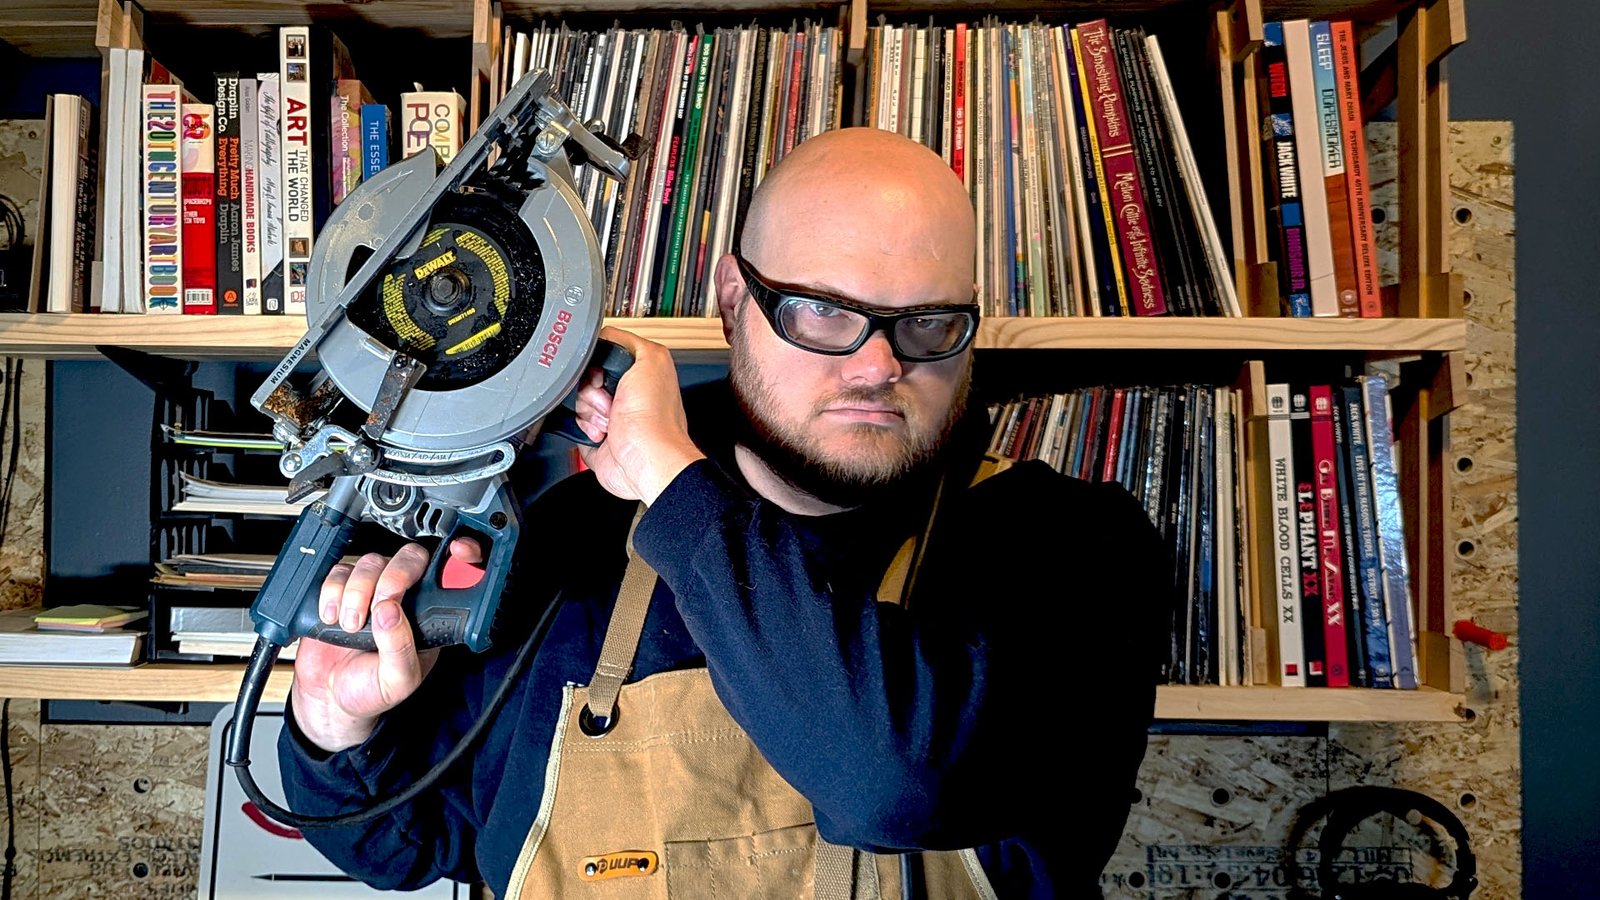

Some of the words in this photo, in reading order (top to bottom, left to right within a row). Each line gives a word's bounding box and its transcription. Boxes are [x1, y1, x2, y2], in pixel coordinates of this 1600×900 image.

[1083, 27, 1106, 46] The
[1339, 30, 1347, 42] THE
[1316, 33, 1332, 71] SLEEP
[1340, 44, 1350, 64] JESUS
[1086, 45, 1112, 93] Smashing
[1269, 62, 1287, 97] WITCH
[1342, 66, 1351, 80] AND
[215, 78, 227, 113] Design
[226, 78, 239, 119] Draplin
[340, 95, 350, 111] The
[1344, 81, 1353, 100] MARY
[218, 113, 227, 134] Co.
[287, 97, 307, 146] ART
[1098, 93, 1121, 138] Pumpkins
[1346, 101, 1355, 122] CHAIN
[341, 111, 351, 152] Collection
[369, 121, 380, 141] THE
[1321, 88, 1342, 168] DOPESMOKER
[216, 138, 229, 196] Everything
[227, 137, 239, 168] Pretty
[288, 150, 298, 174] THE
[300, 150, 309, 173] THAT
[370, 145, 381, 175] ESSE
[1277, 141, 1295, 166] JACK
[1349, 130, 1361, 177] PSYCHOCANDY
[230, 169, 239, 199] Much
[245, 169, 255, 220] HANDMADE
[1114, 172, 1133, 203] Mellon
[1280, 166, 1298, 199] WHITE
[1354, 179, 1364, 196] 40TH
[288, 176, 299, 222] WORLD
[300, 176, 309, 222] CHANGED
[1120, 203, 1140, 226] Collie
[217, 203, 229, 244] Draplin
[230, 203, 240, 236] Aaron
[1357, 197, 1368, 242] ANNIVERSARY
[246, 222, 256, 254] BOOKS
[1286, 228, 1304, 277] DINOSAUR
[230, 237, 240, 272] James
[1129, 239, 1147, 270] Infinite
[1361, 243, 1371, 268] DELUXE
[1132, 268, 1156, 309] Sadness
[1291, 279, 1306, 293] JR.
[1364, 269, 1374, 296] EDITION
[537, 308, 573, 369] BOSCH
[270, 337, 311, 385] MAGNESIUM
[1349, 402, 1360, 421] JACK
[1352, 421, 1362, 446] WHITE
[1274, 457, 1288, 501] WHITE
[1354, 455, 1364, 472] LIVE
[1356, 473, 1366, 481] AT
[1358, 482, 1366, 496] THE
[1298, 482, 1317, 570] ELEPHANT
[1359, 497, 1370, 529] MASONIC
[1277, 507, 1291, 551] BLOOD
[1362, 530, 1373, 558] TEMPLE
[1280, 556, 1293, 600] CELLS
[1302, 571, 1319, 597] XX
[1367, 567, 1378, 599] DETROIT
[1283, 605, 1294, 623] XX
[1326, 602, 1342, 627] XX
